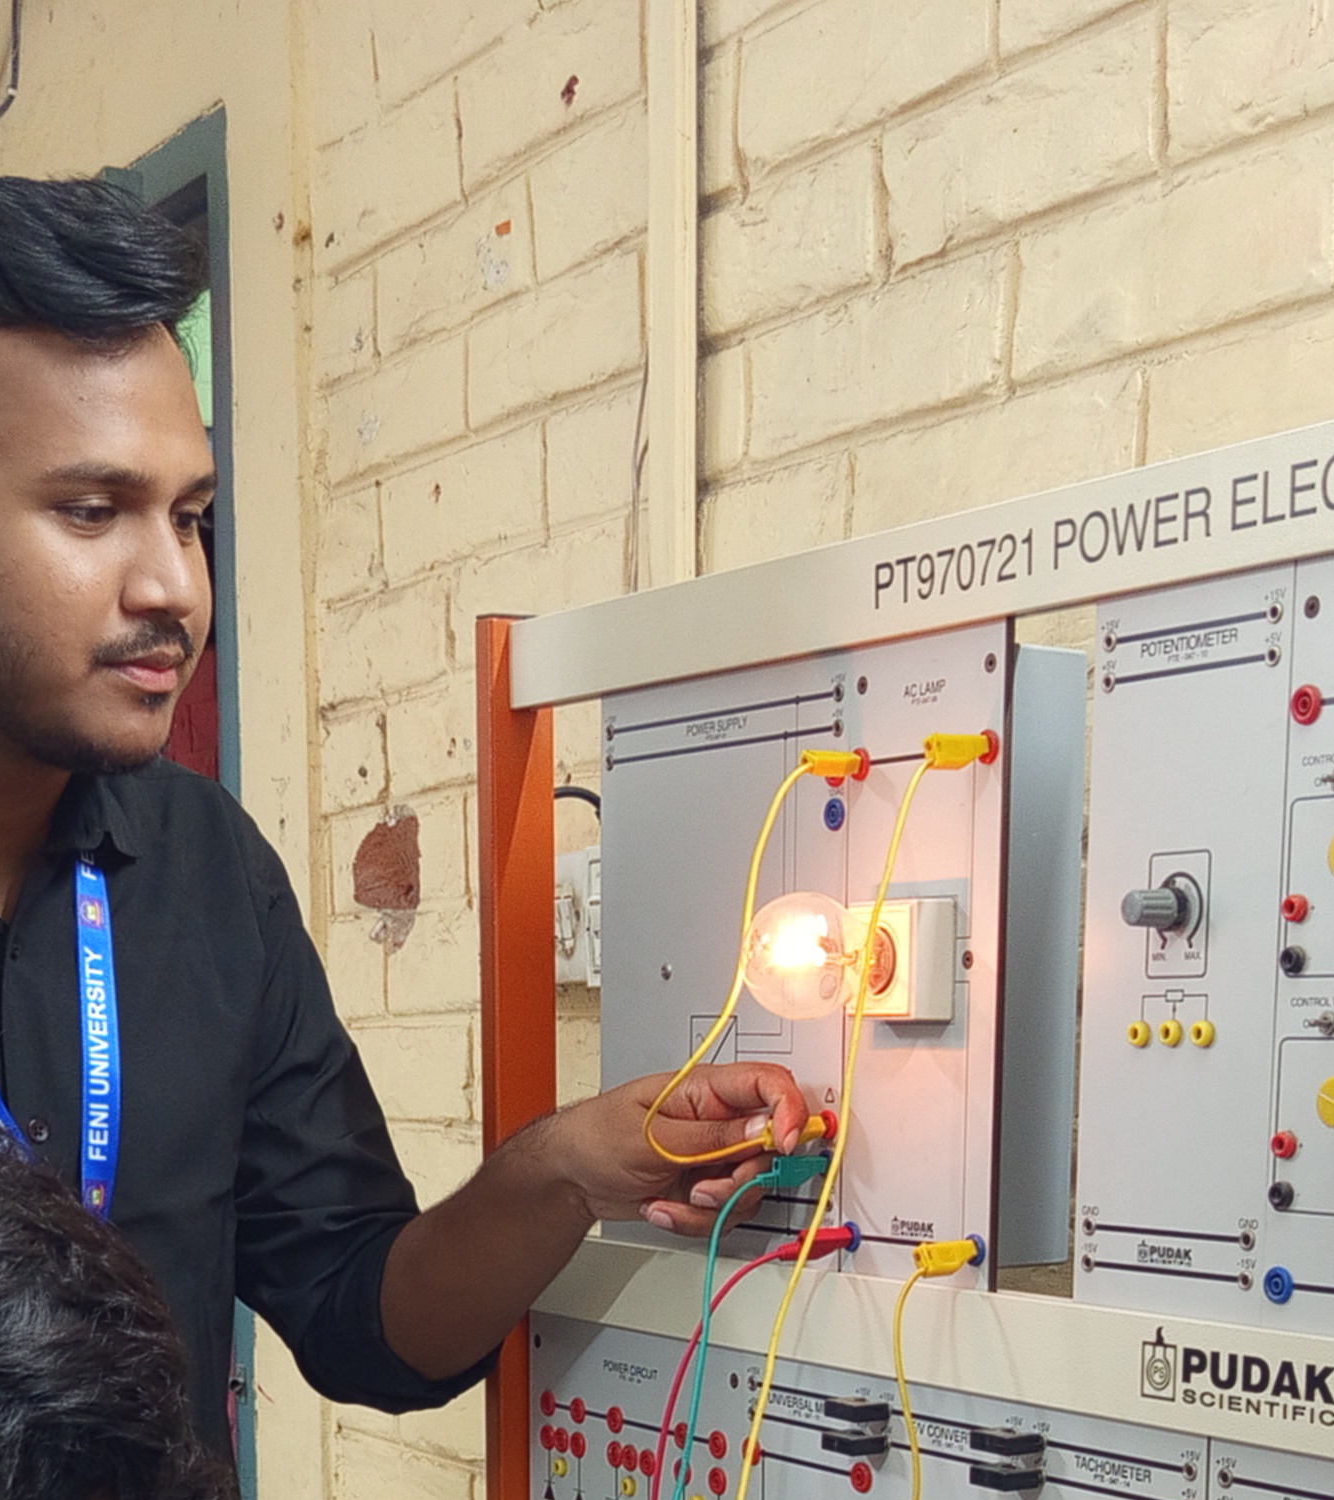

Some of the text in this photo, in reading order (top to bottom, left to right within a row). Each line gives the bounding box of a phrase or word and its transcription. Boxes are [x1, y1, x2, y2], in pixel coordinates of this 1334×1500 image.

[874, 527, 1036, 610] PT970721
[1054, 486, 1213, 571] POWER
[1140, 628, 1238, 659] POTENTIOMETER
[903, 678, 947, 698] AC LAMP
[716, 716, 748, 732] SUPPLY
[1291, 996, 1331, 1008] CONTROL
[83, 945, 111, 1161] FENI UNIVERSITY
[899, 1219, 935, 1233] PUDAK
[1238, 1218, 1259, 1230] GND
[1149, 1245, 1193, 1262] PUDAK
[1074, 1455, 1152, 1484] TACHOMETER
